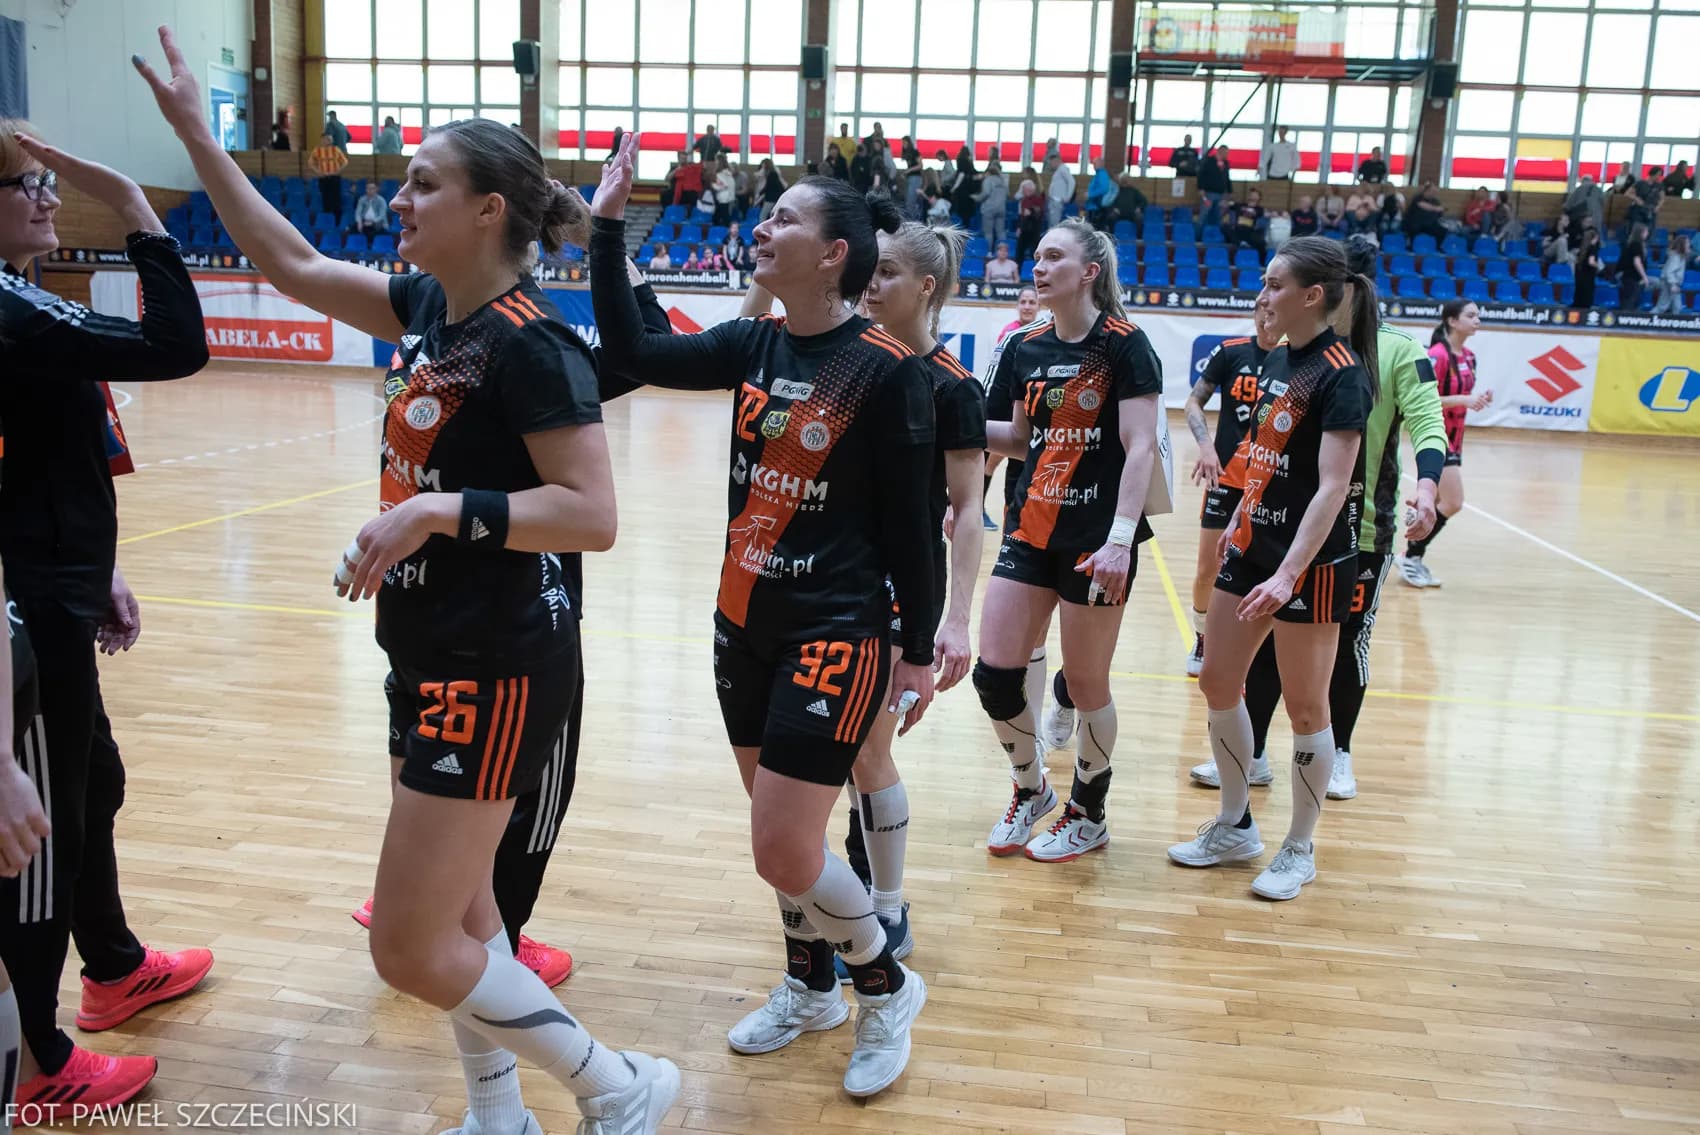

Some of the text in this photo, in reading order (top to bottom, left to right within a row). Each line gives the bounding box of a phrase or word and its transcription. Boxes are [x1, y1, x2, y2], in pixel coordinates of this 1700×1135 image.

[206, 327, 323, 351] ABELA-CK
[1230, 376, 1257, 402] 49
[1520, 404, 1582, 417] SUZUKI
[1044, 427, 1101, 443] KGHM
[751, 463, 829, 501] KGHM
[1044, 482, 1099, 505] lubin.pl
[792, 640, 853, 697] 92
[417, 680, 479, 745] 26
[431, 763, 464, 775] adidas
